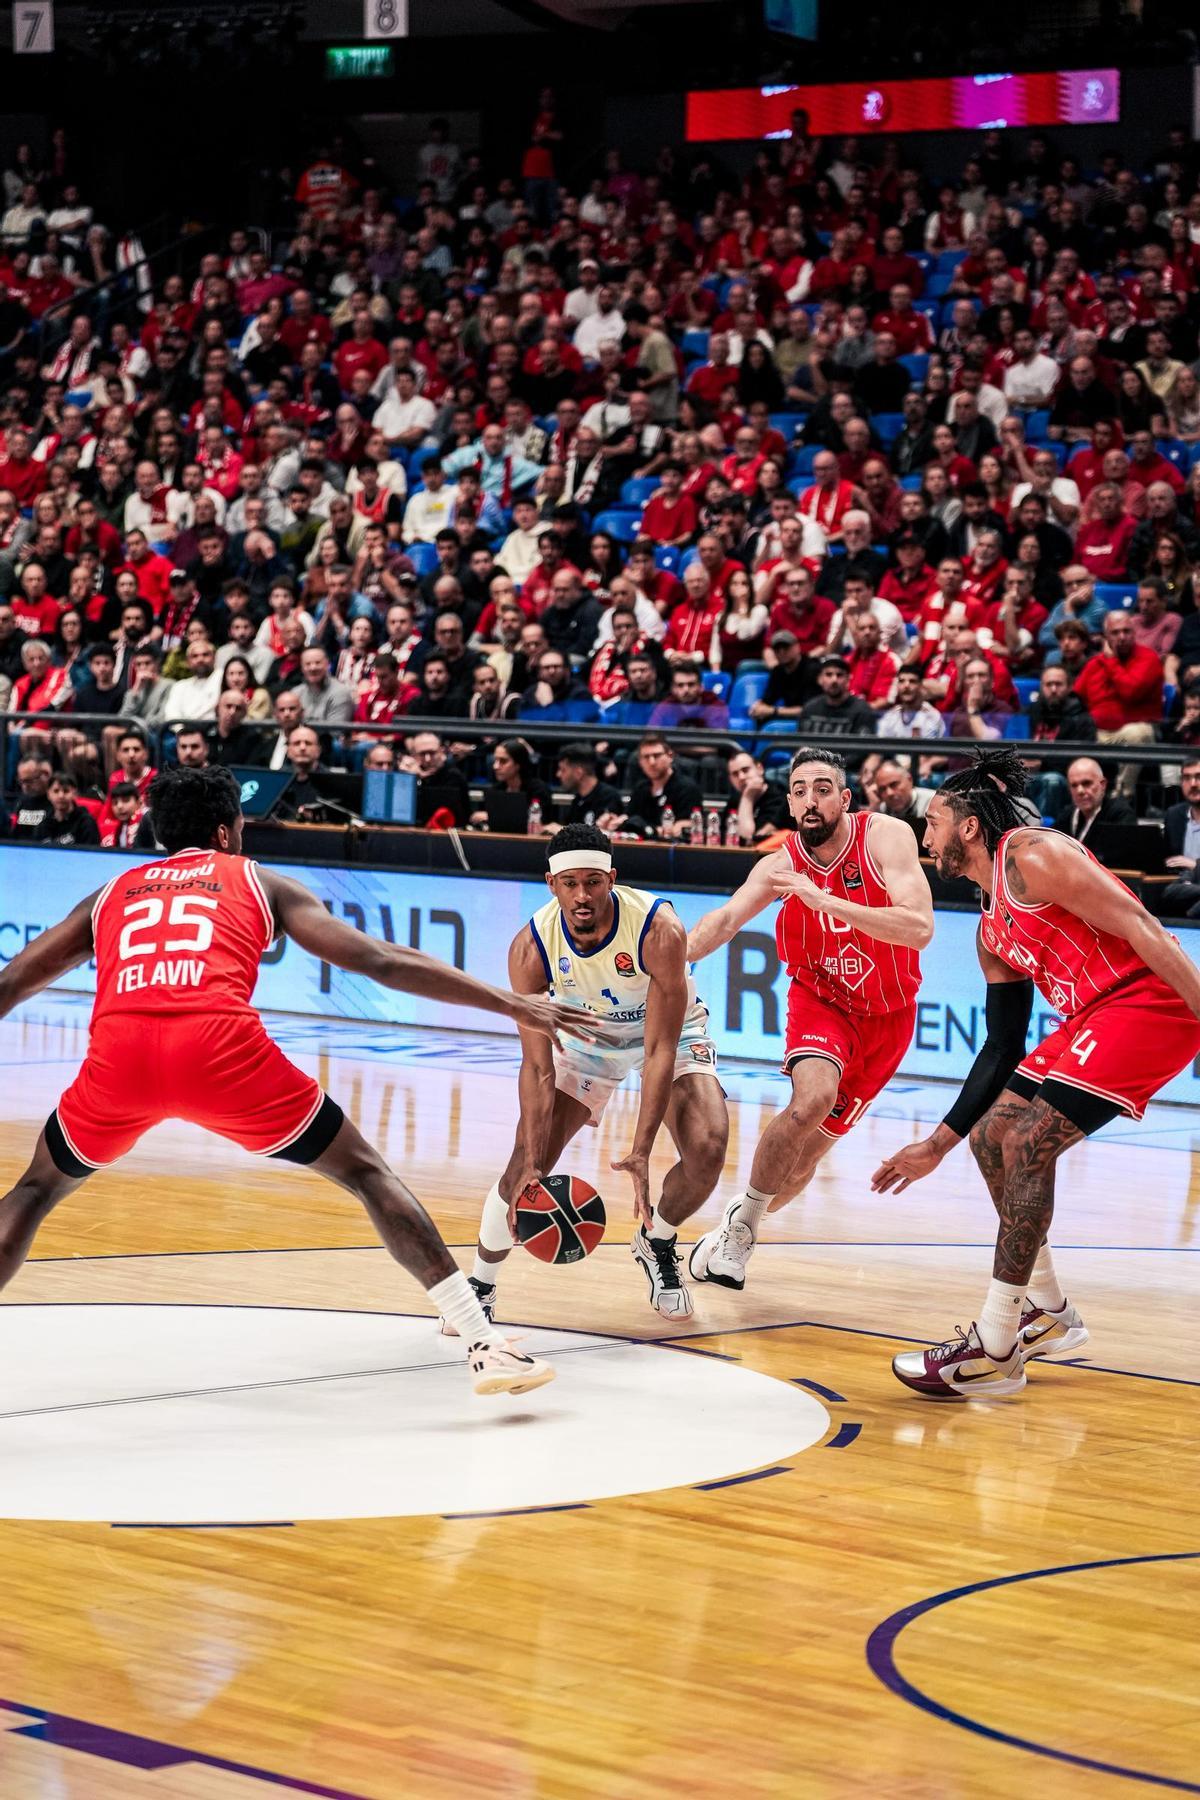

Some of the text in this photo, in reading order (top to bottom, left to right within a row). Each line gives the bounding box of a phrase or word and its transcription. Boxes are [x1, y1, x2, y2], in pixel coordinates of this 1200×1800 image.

[21, 10, 45, 49] 7
[374, 0, 399, 34] 8
[144, 863, 216, 881] OTURU
[119, 895, 219, 960] 25
[116, 960, 206, 994] TEL AVIV
[840, 957, 864, 975] IBI
[1070, 1028, 1098, 1067] 4
